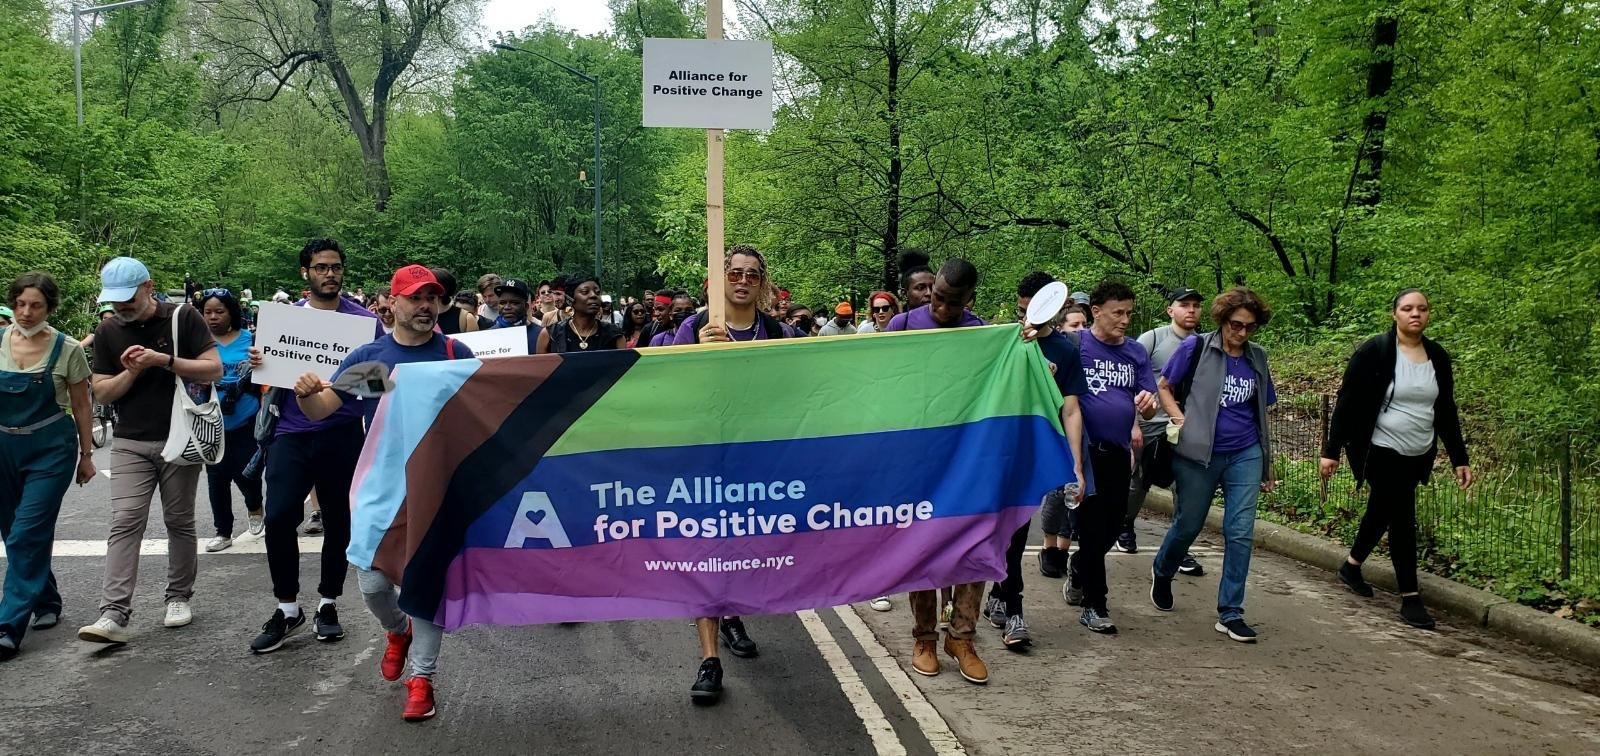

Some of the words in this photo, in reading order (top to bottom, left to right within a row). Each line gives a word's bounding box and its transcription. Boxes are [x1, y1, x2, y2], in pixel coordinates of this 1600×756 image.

[668, 70, 724, 81] Alliance
[728, 72, 748, 82] for
[653, 85, 707, 96] Positive
[711, 86, 763, 99] Change
[278, 334, 329, 350] Alliance
[332, 342, 350, 353] for
[263, 346, 312, 362] Positive
[315, 354, 343, 366] Cha
[1093, 359, 1115, 370] Talk
[1117, 362, 1128, 371] to
[590, 481, 656, 509] The
[665, 475, 806, 504] Alliance
[503, 491, 573, 548] A
[593, 514, 645, 543] for
[656, 507, 797, 538] Positive
[806, 500, 934, 531] Change
[644, 555, 795, 573] www.alliance.nyc
